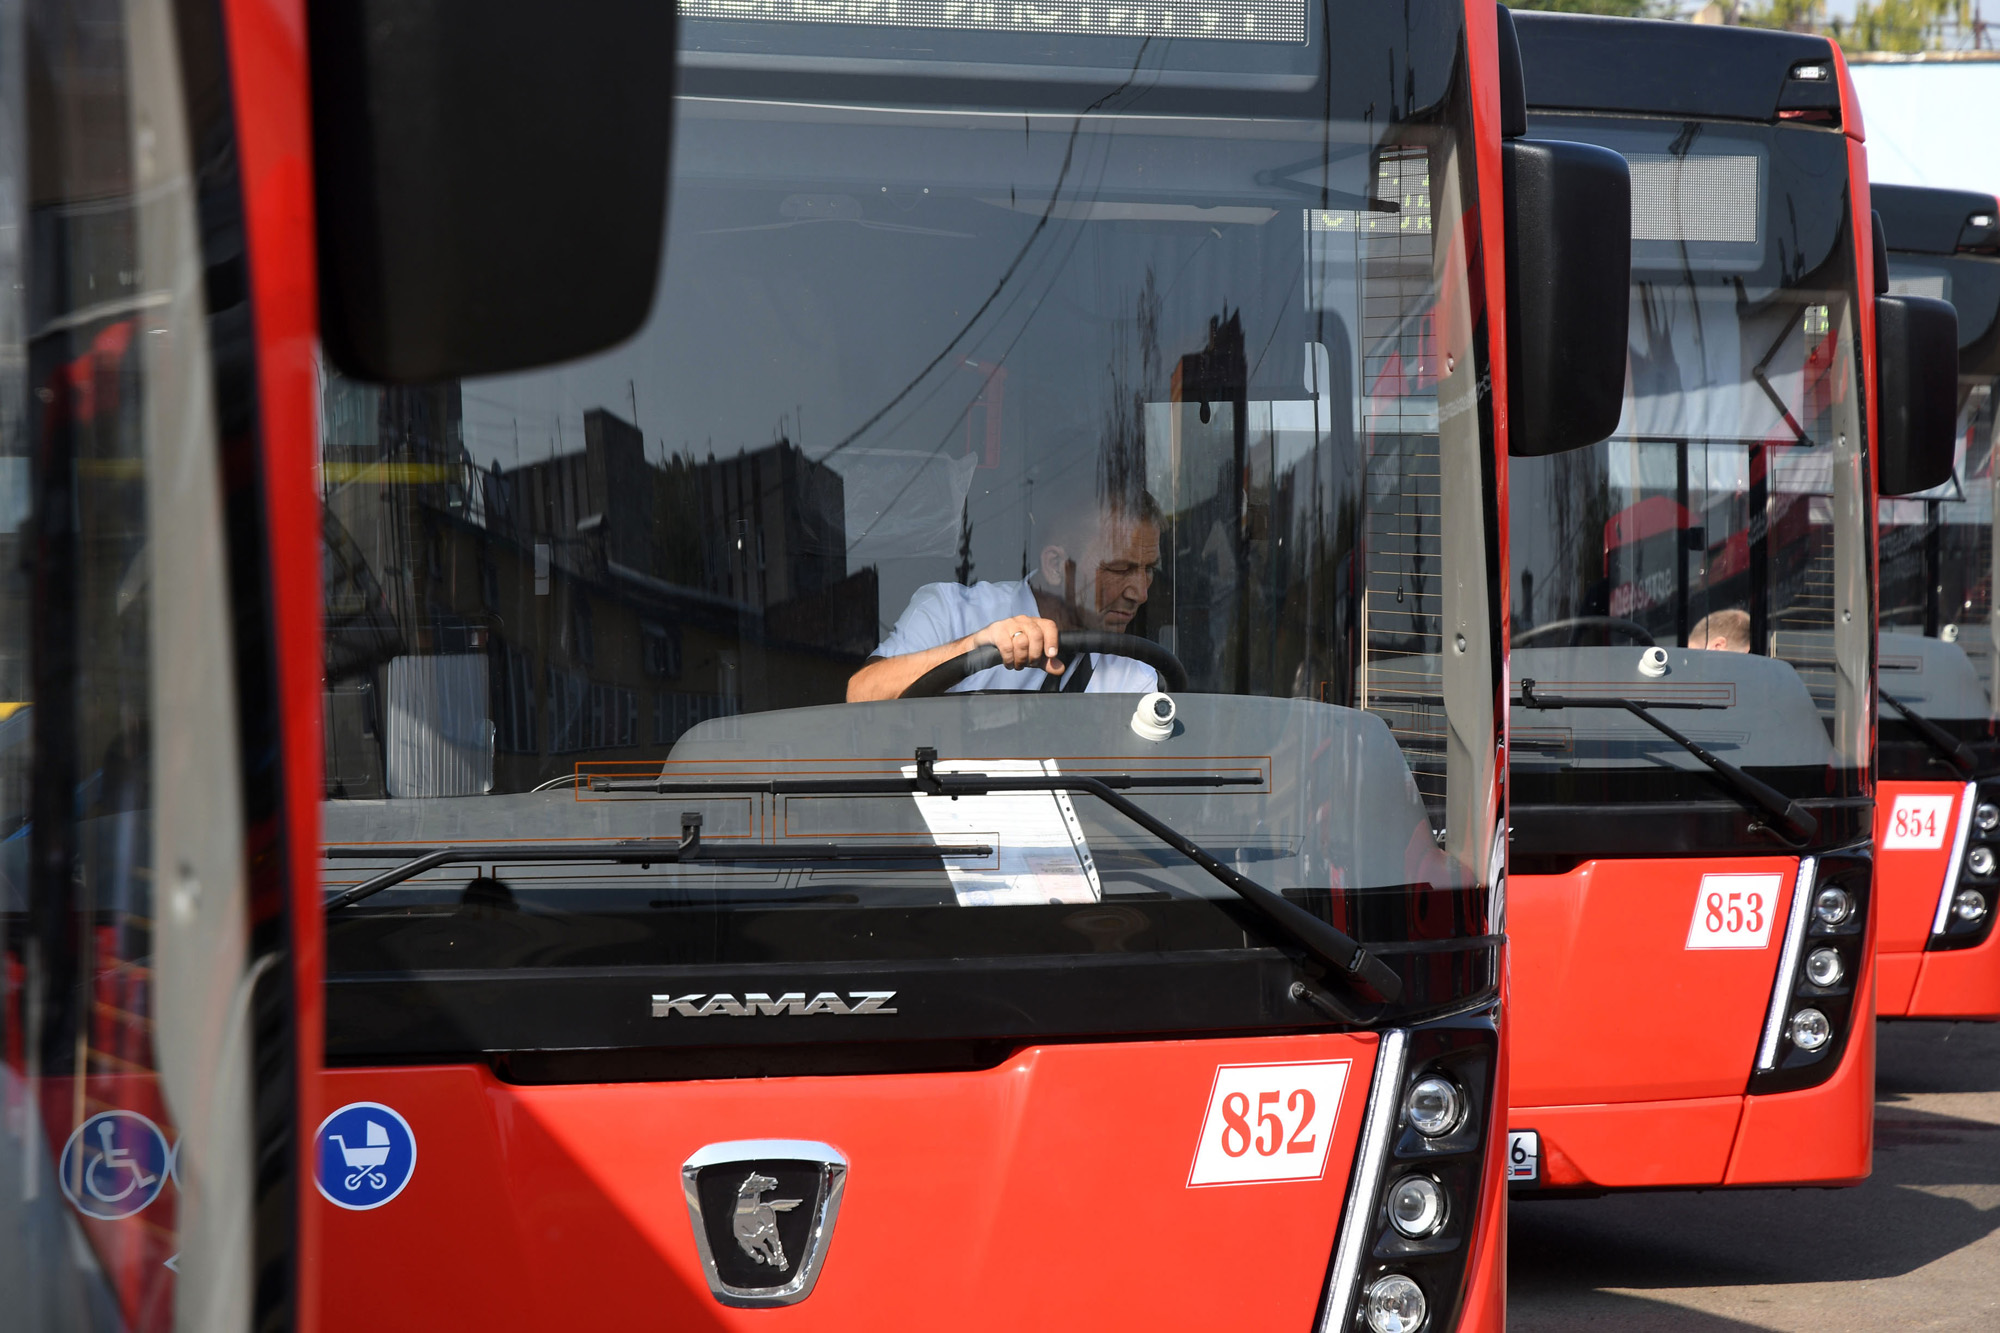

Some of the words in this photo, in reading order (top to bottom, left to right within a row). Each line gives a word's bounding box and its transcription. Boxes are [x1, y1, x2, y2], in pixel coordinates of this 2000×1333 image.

[1895, 808, 1936, 838] 854
[1705, 892, 1764, 933] 853
[652, 991, 898, 1017] KAMAZ
[1221, 1088, 1316, 1158] 852
